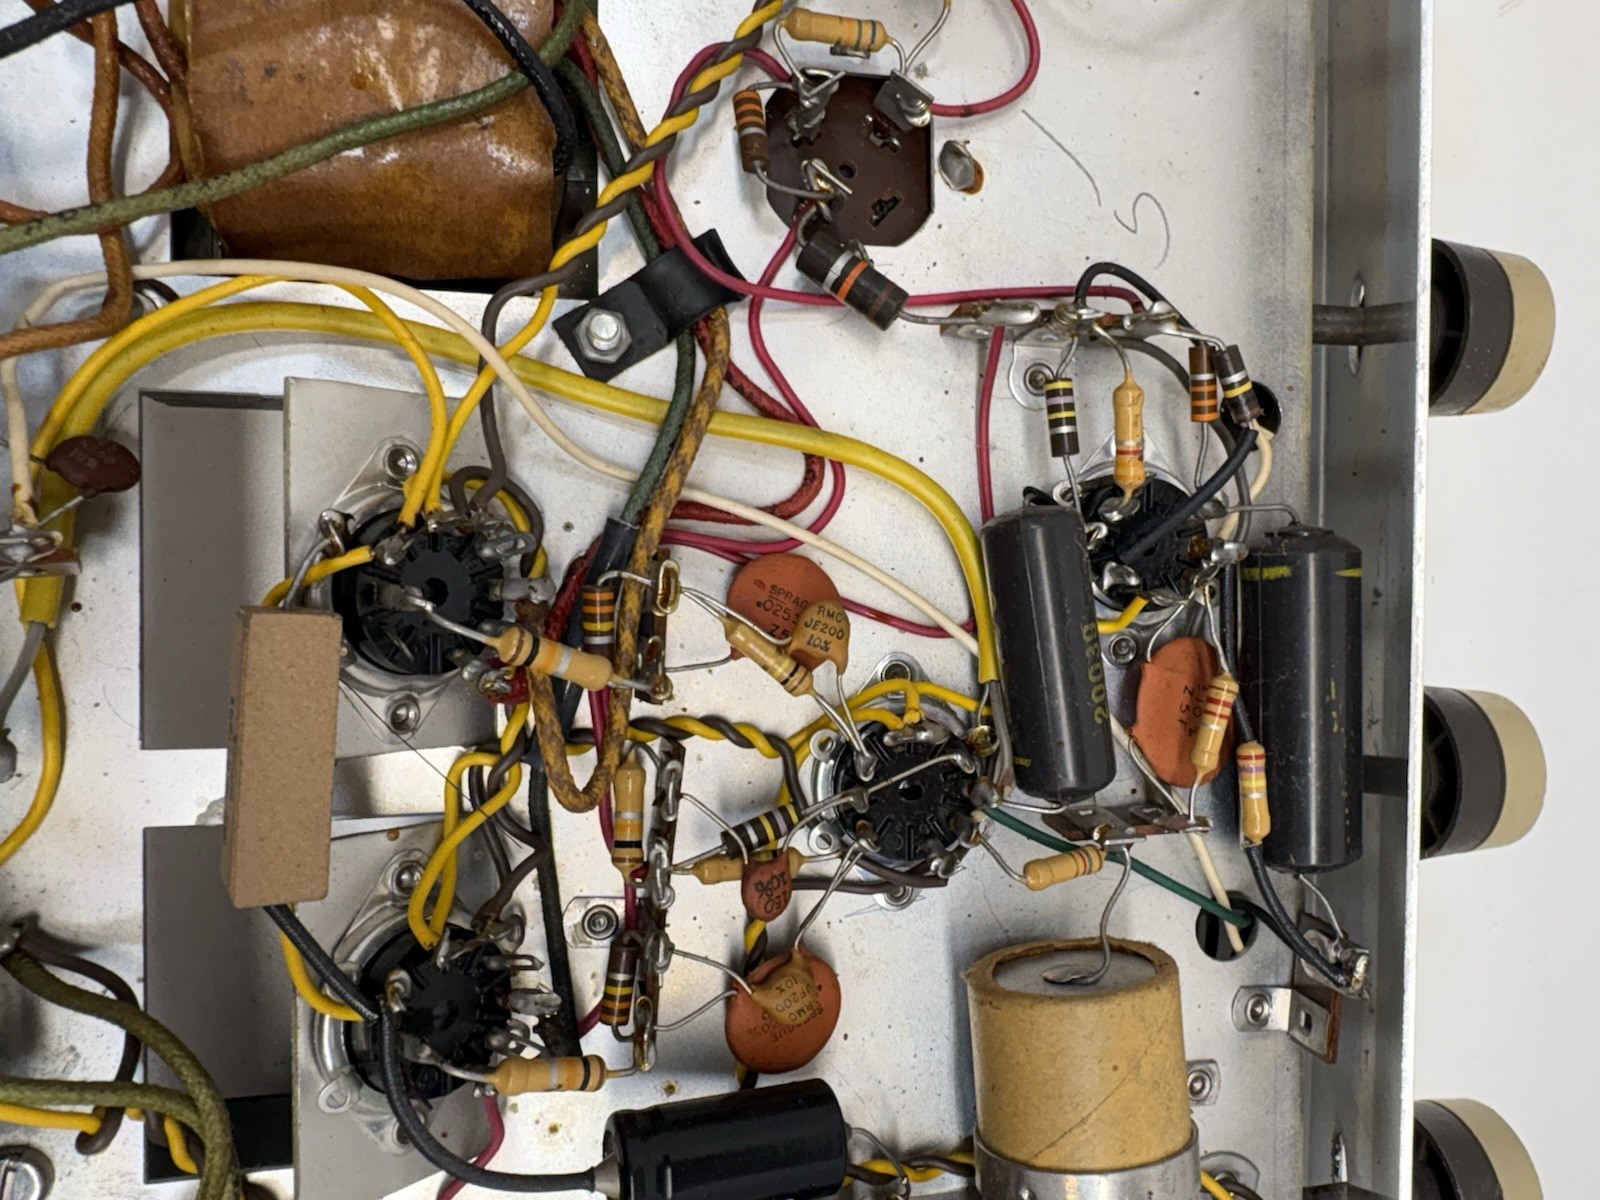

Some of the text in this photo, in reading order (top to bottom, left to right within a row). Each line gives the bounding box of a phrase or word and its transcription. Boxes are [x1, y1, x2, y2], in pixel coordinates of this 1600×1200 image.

[769, 584, 810, 610] SPRAG
[817, 605, 843, 624] RMC
[767, 623, 791, 640] Z5
[804, 618, 845, 640] JE200
[788, 1002, 814, 1022] RMC
[771, 1003, 824, 1043] SPGUE
